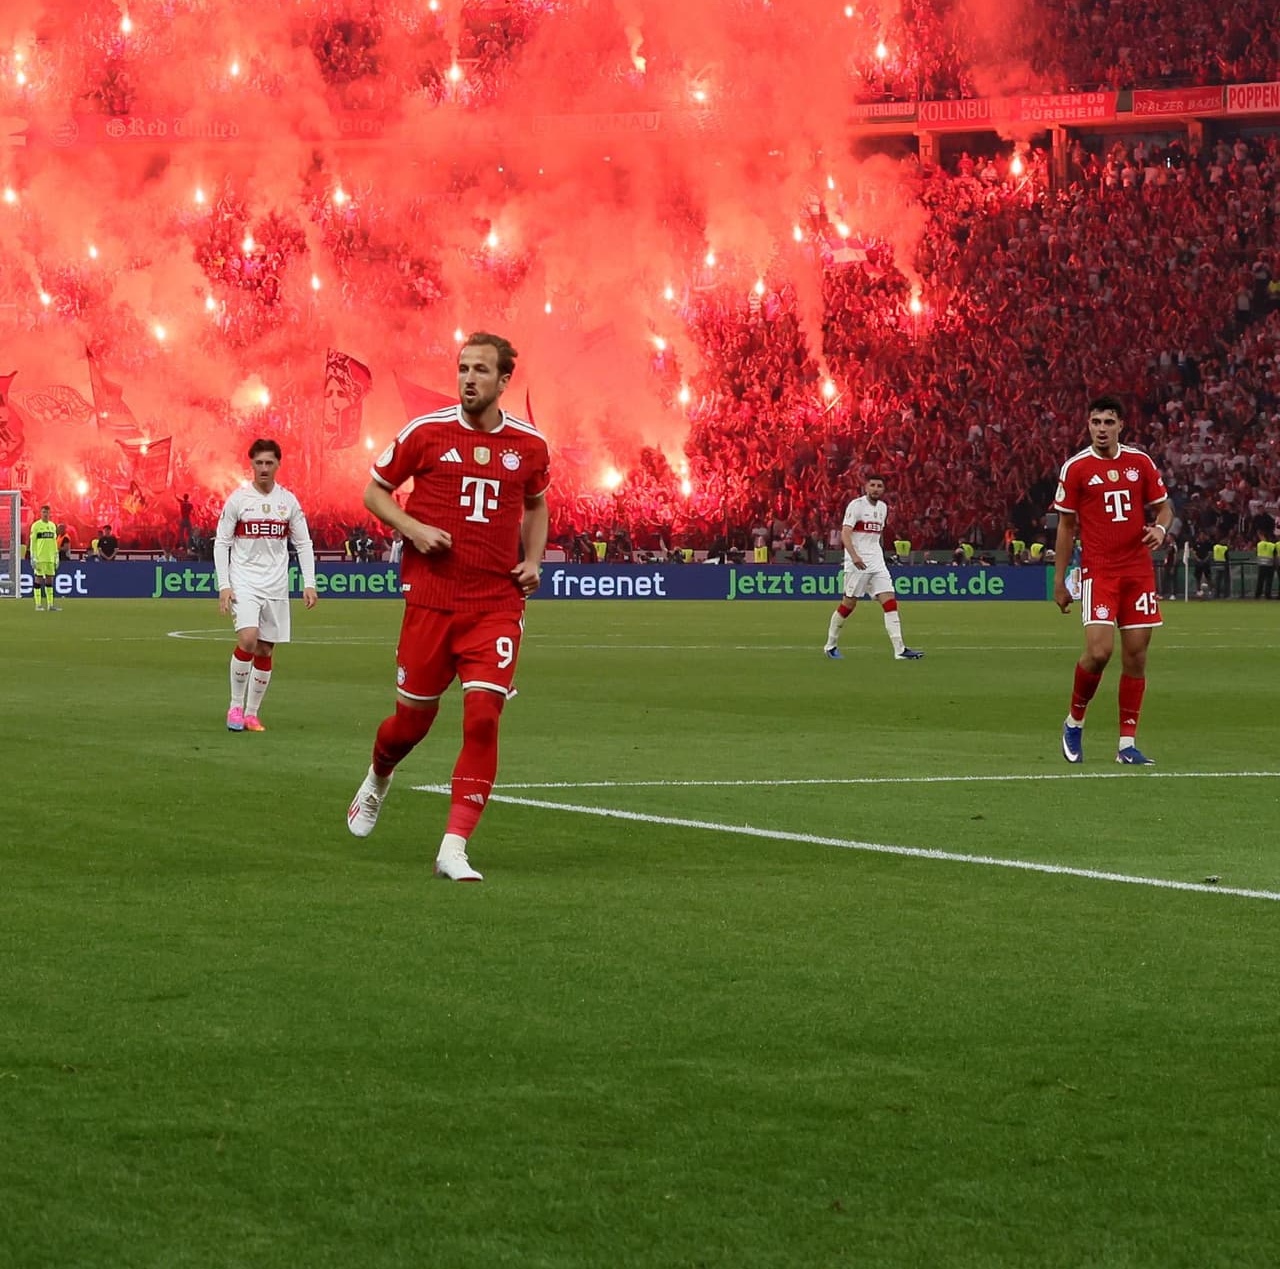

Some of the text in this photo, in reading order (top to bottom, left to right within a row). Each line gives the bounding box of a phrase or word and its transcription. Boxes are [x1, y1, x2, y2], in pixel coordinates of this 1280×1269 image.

[152, 566, 218, 598] Jetzt
[552, 569, 666, 596] freenet
[727, 569, 794, 600] Jetzt
[1135, 592, 1158, 615] 45
[496, 636, 514, 669] 9
